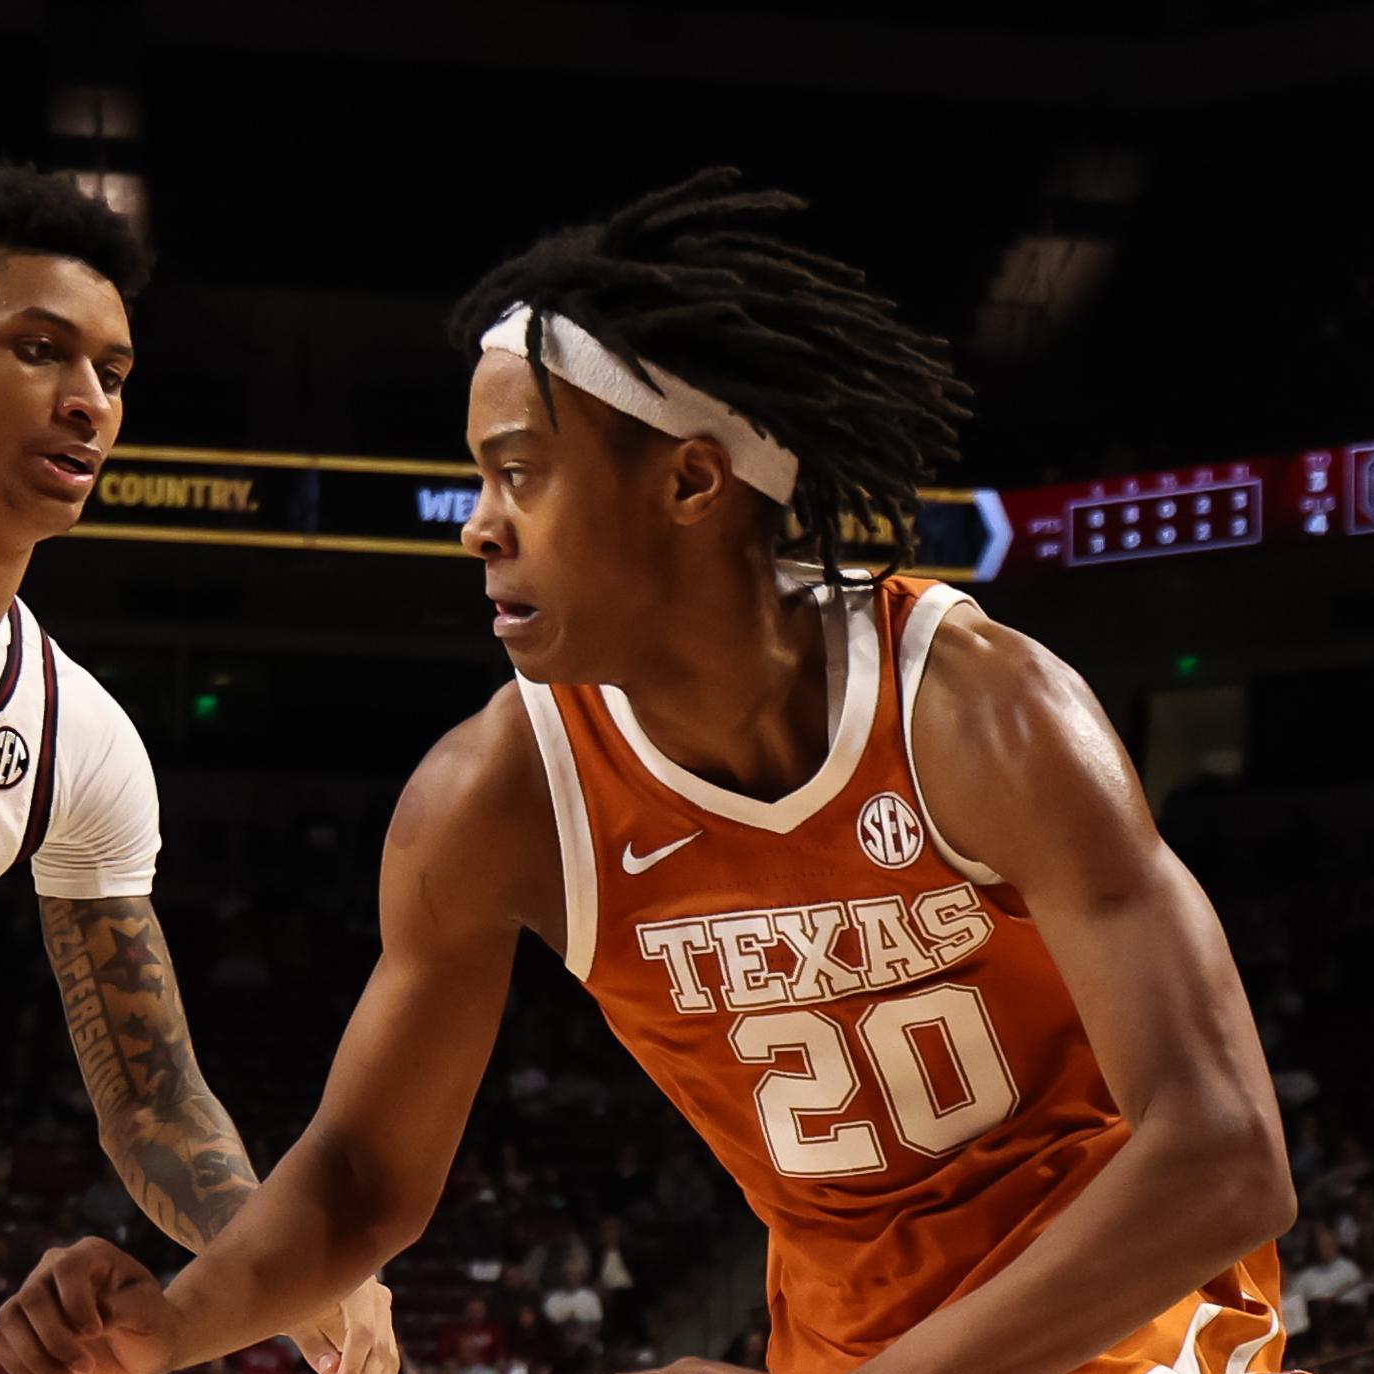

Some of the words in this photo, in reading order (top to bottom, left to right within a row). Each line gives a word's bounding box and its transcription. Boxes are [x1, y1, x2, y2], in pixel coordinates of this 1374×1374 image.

[100, 472, 259, 512] COUNTRY.
[862, 797, 921, 864] SEC
[635, 881, 995, 1014] TEXAS
[727, 983, 1020, 1179] 20
